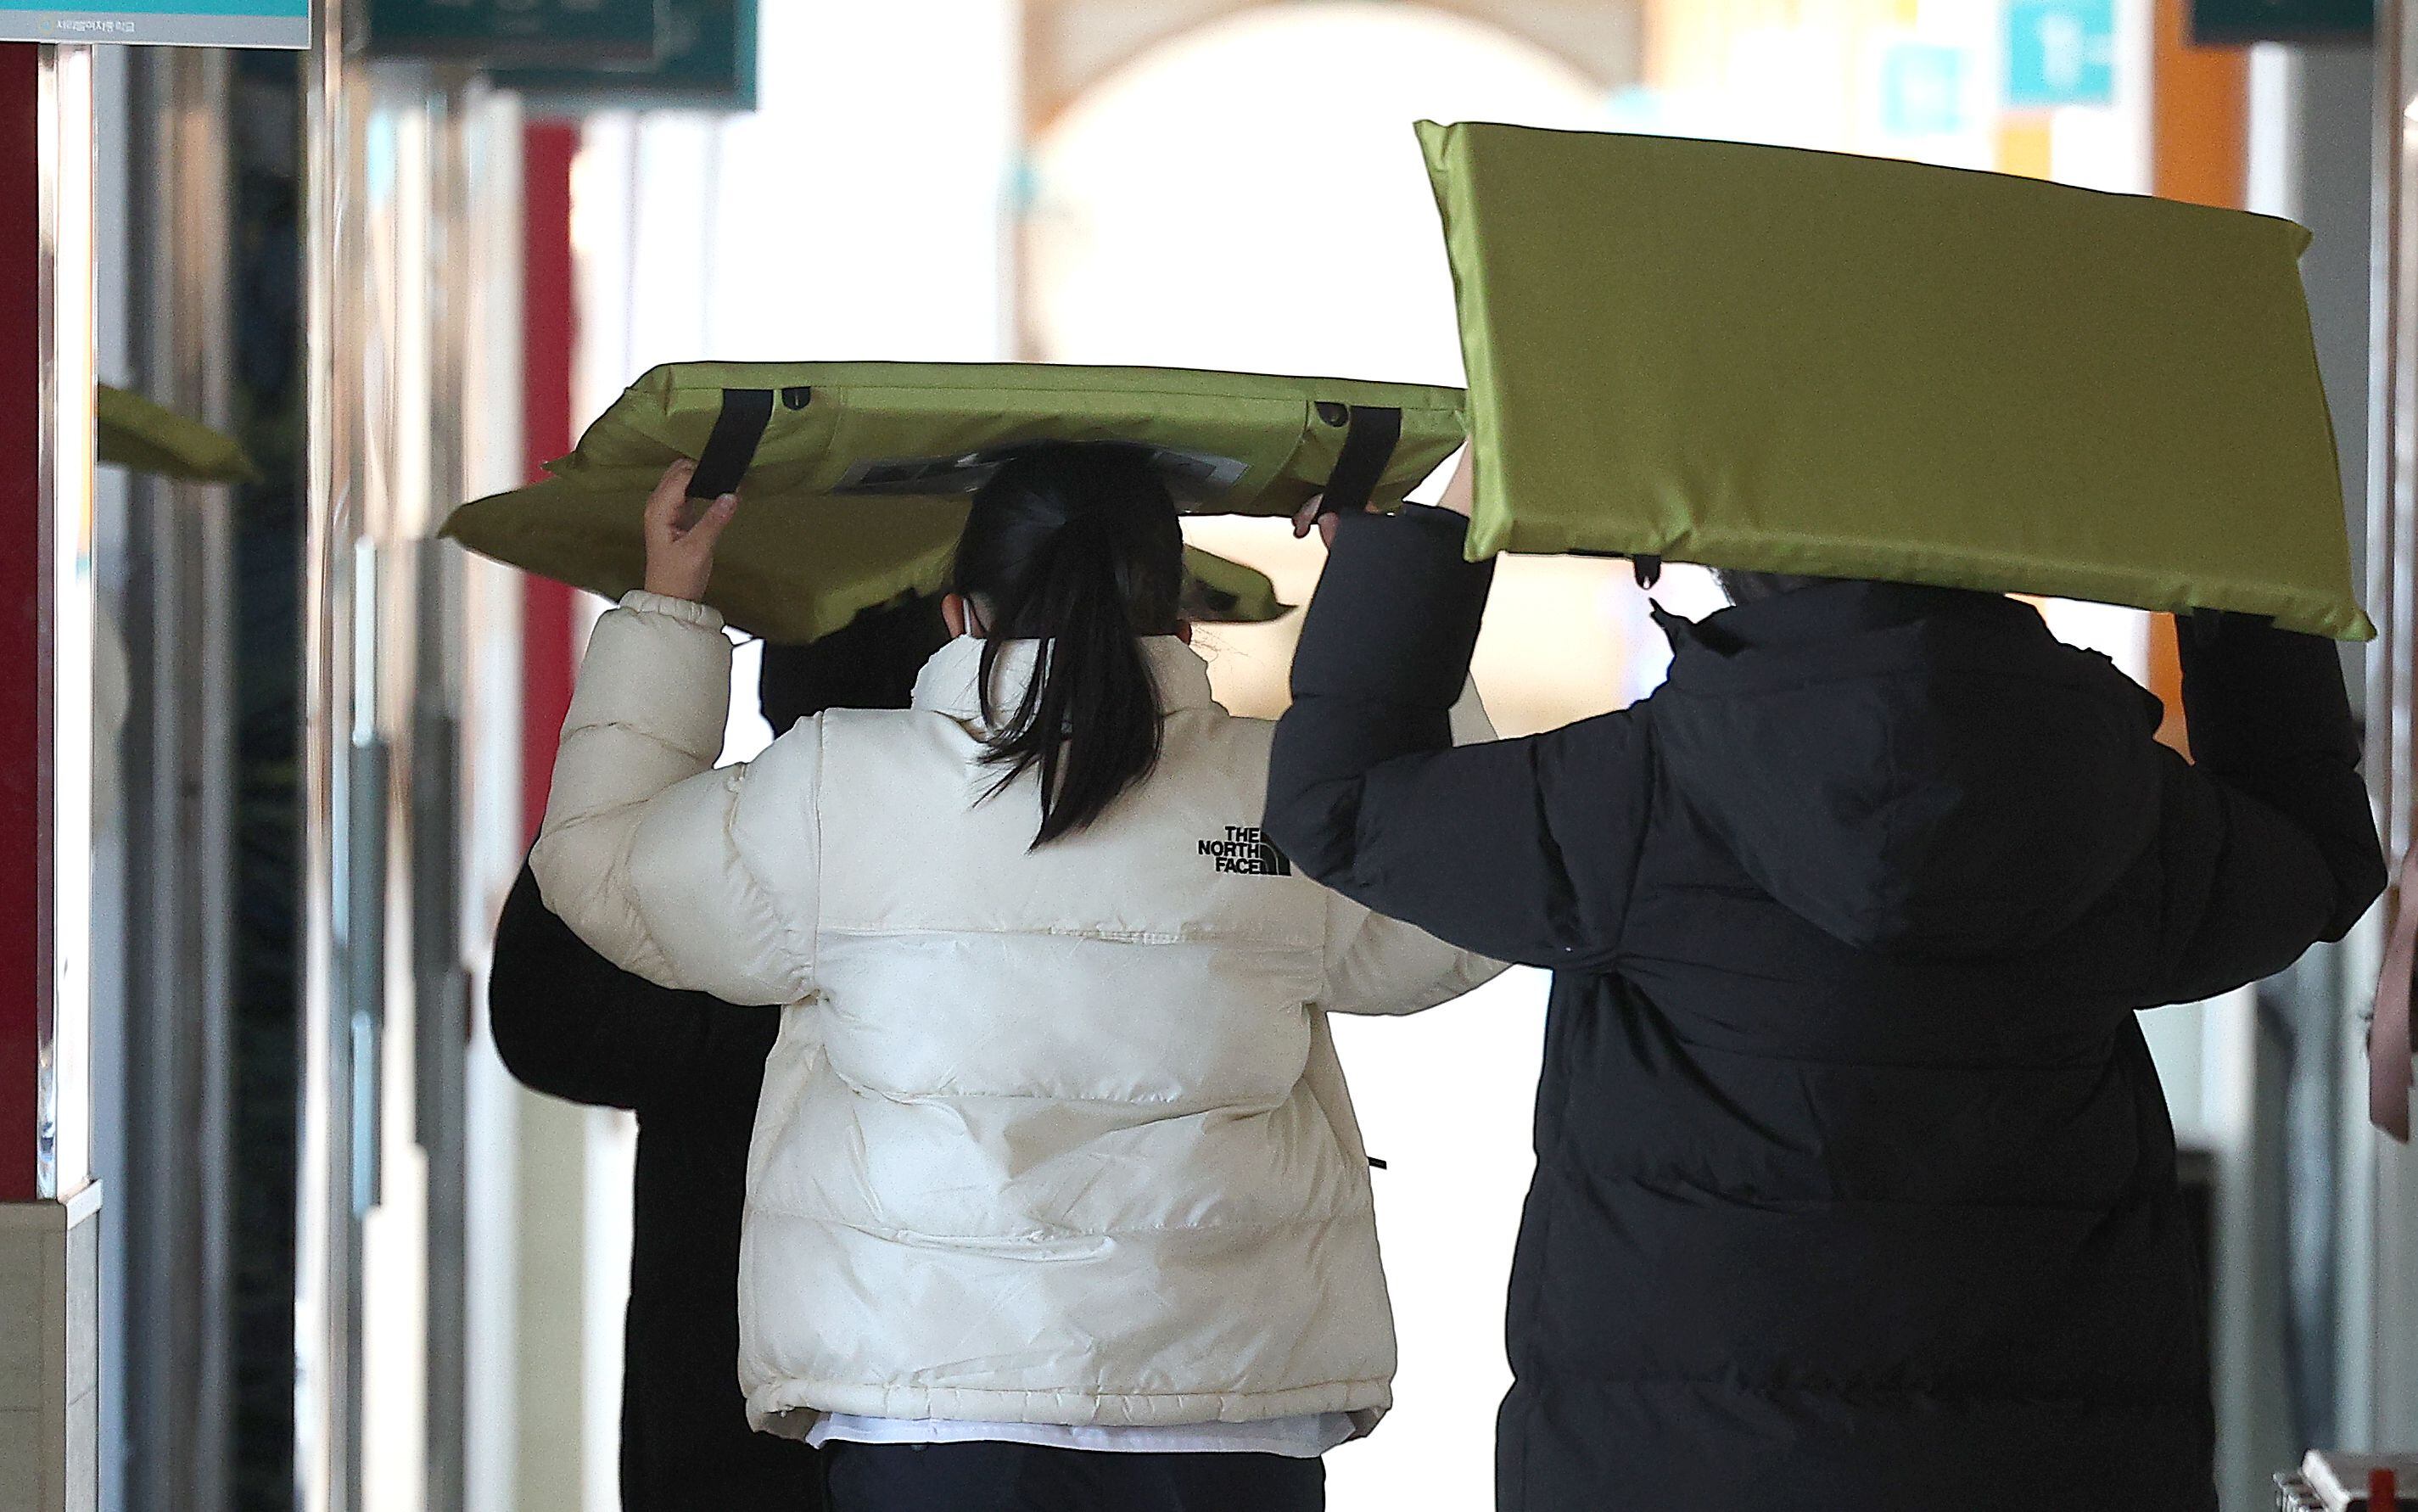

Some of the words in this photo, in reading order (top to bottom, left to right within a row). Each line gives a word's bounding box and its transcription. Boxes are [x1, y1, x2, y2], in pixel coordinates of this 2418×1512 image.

[1224, 826, 1260, 843] THE
[1198, 840, 1259, 859] NORTH
[1215, 857, 1262, 875] FACE
